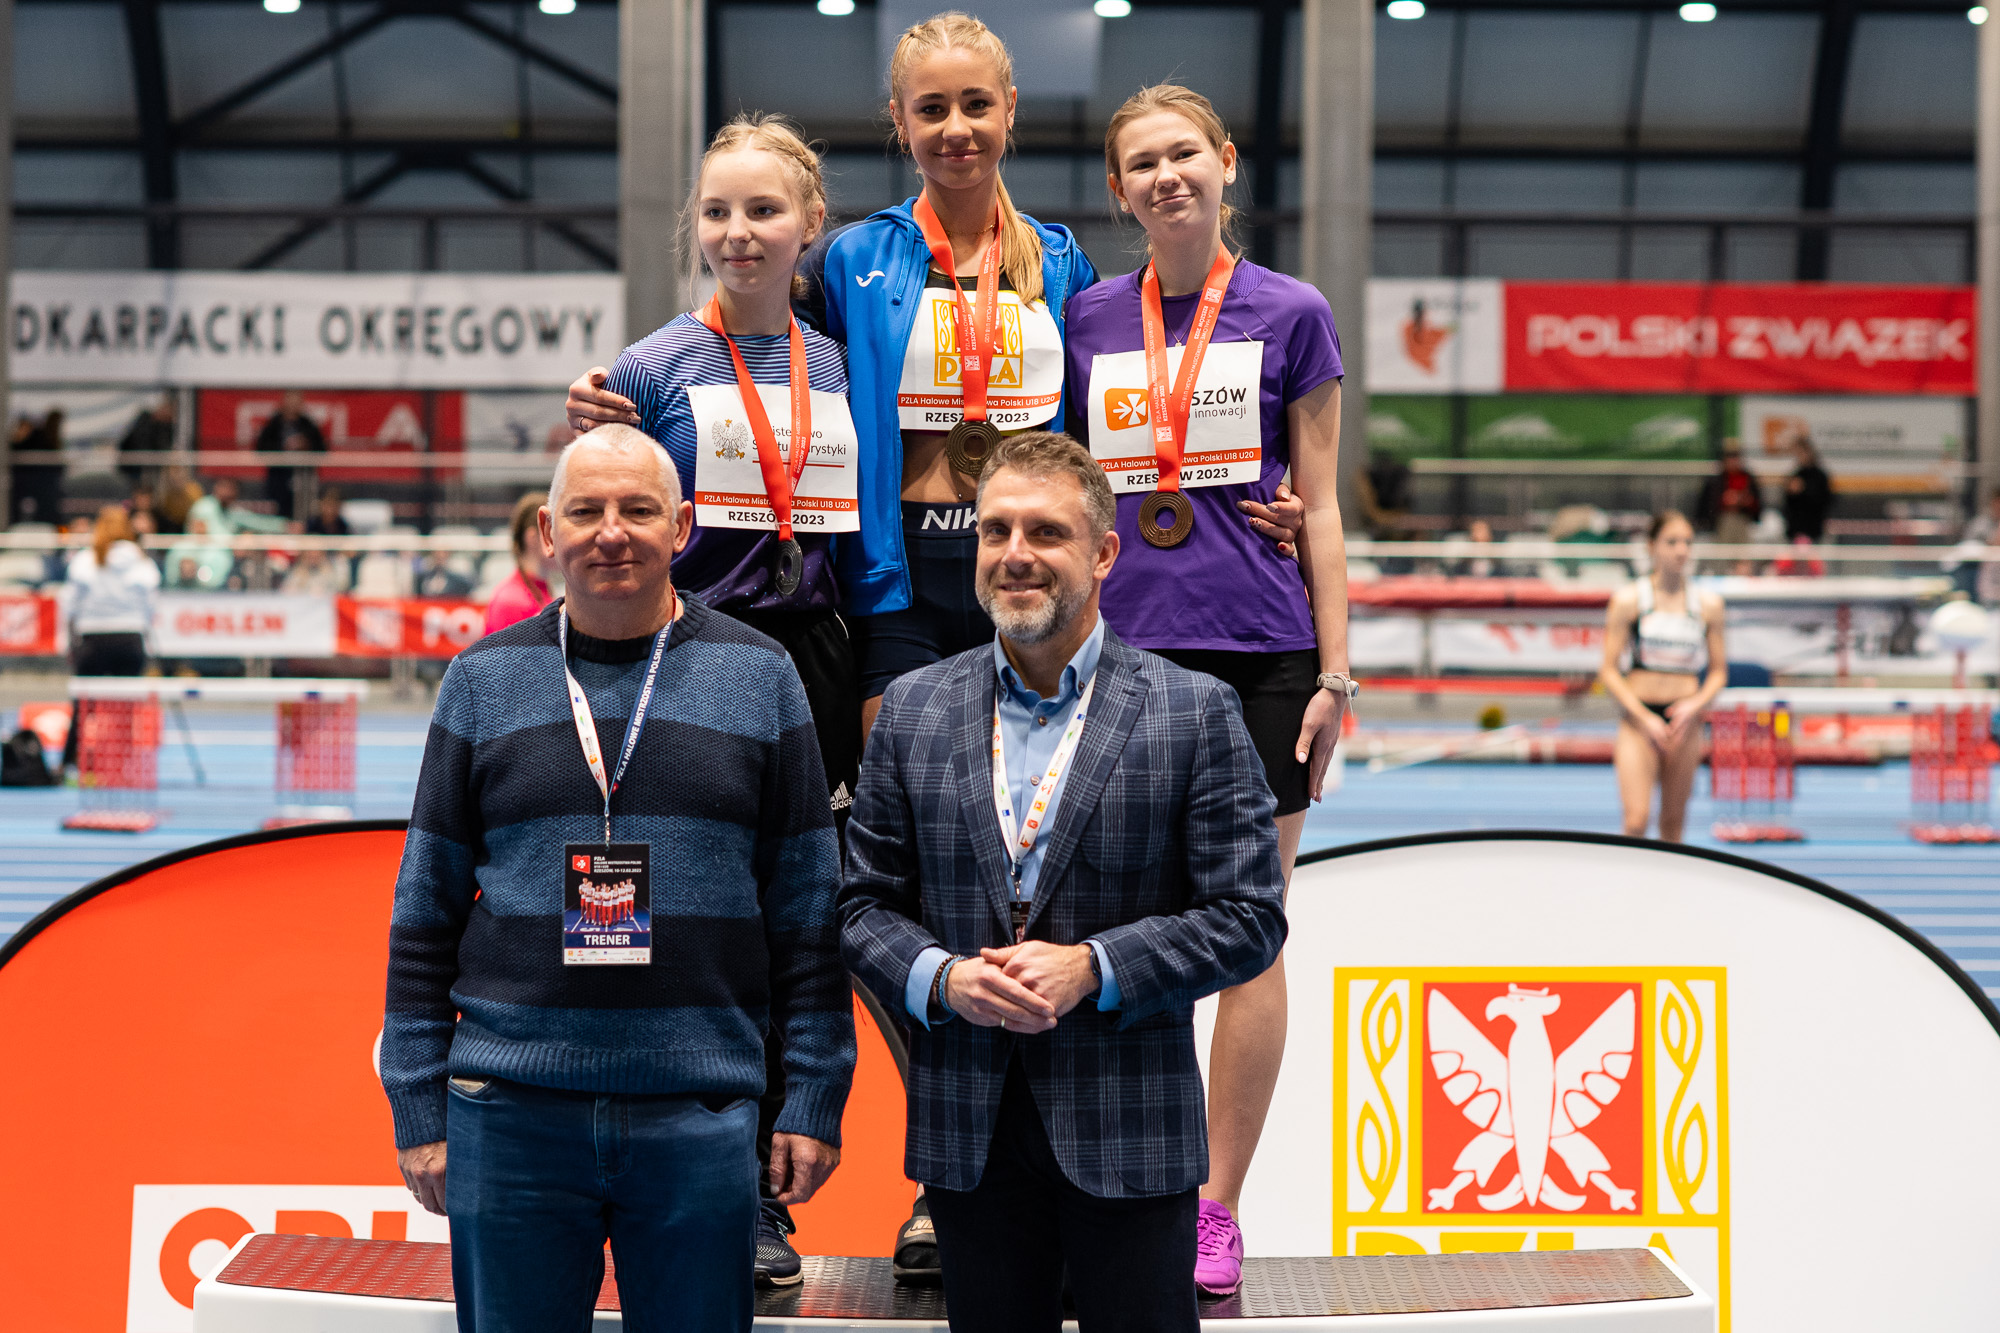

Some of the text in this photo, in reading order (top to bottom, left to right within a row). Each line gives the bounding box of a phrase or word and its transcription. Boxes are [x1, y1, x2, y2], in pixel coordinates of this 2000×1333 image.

[318, 304, 604, 359] OKRĘGOWY
[1526, 314, 1972, 366] POLSKI ZWIĄZEK
[900, 396, 919, 404] PZLA
[920, 397, 950, 405] Halowe
[1000, 399, 1024, 407] Polski
[1025, 398, 1039, 406] U18
[1040, 395, 1056, 404] U20
[1191, 386, 1247, 406] SZÓW
[996, 412, 1030, 423] 2023
[1194, 405, 1247, 419] innowacji
[1200, 453, 1223, 462] Polski
[1224, 452, 1238, 460] U18
[1239, 450, 1255, 459] U20
[1101, 461, 1120, 470] PZLA
[1120, 459, 1151, 469] Halowe
[1127, 467, 1229, 486] RZESW 2023
[704, 494, 721, 503] PZLA
[722, 496, 750, 505] Halowe
[796, 500, 819, 508] Polski
[820, 500, 834, 508] U18
[834, 501, 851, 509] U20
[728, 509, 825, 525] RZESZÓ 2023
[921, 507, 979, 530] NIK
[616, 760, 629, 781] PZLA
[623, 725, 640, 760] HALOWE
[633, 674, 656, 727] MISTRZOSTWA
[648, 648, 663, 674] POLSKI
[656, 632, 667, 648] U18
[830, 796, 853, 810] adidas
[583, 934, 631, 946] TRENER
